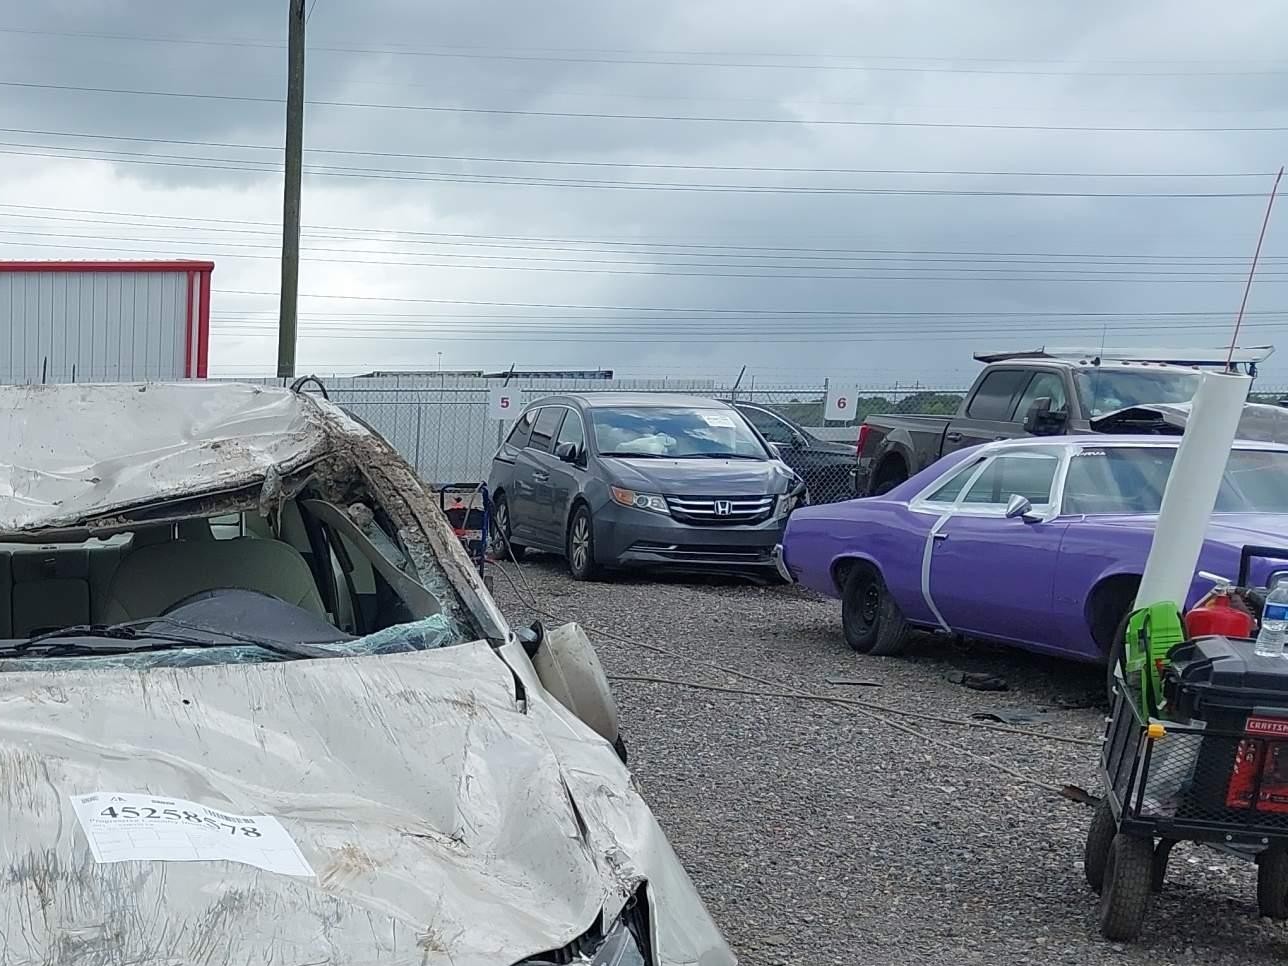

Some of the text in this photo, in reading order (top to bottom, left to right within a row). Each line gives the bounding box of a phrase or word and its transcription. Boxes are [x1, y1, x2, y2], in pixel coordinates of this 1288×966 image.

[500, 396, 510, 409] 5
[837, 397, 847, 409] 6
[100, 806, 262, 837] 45258578
